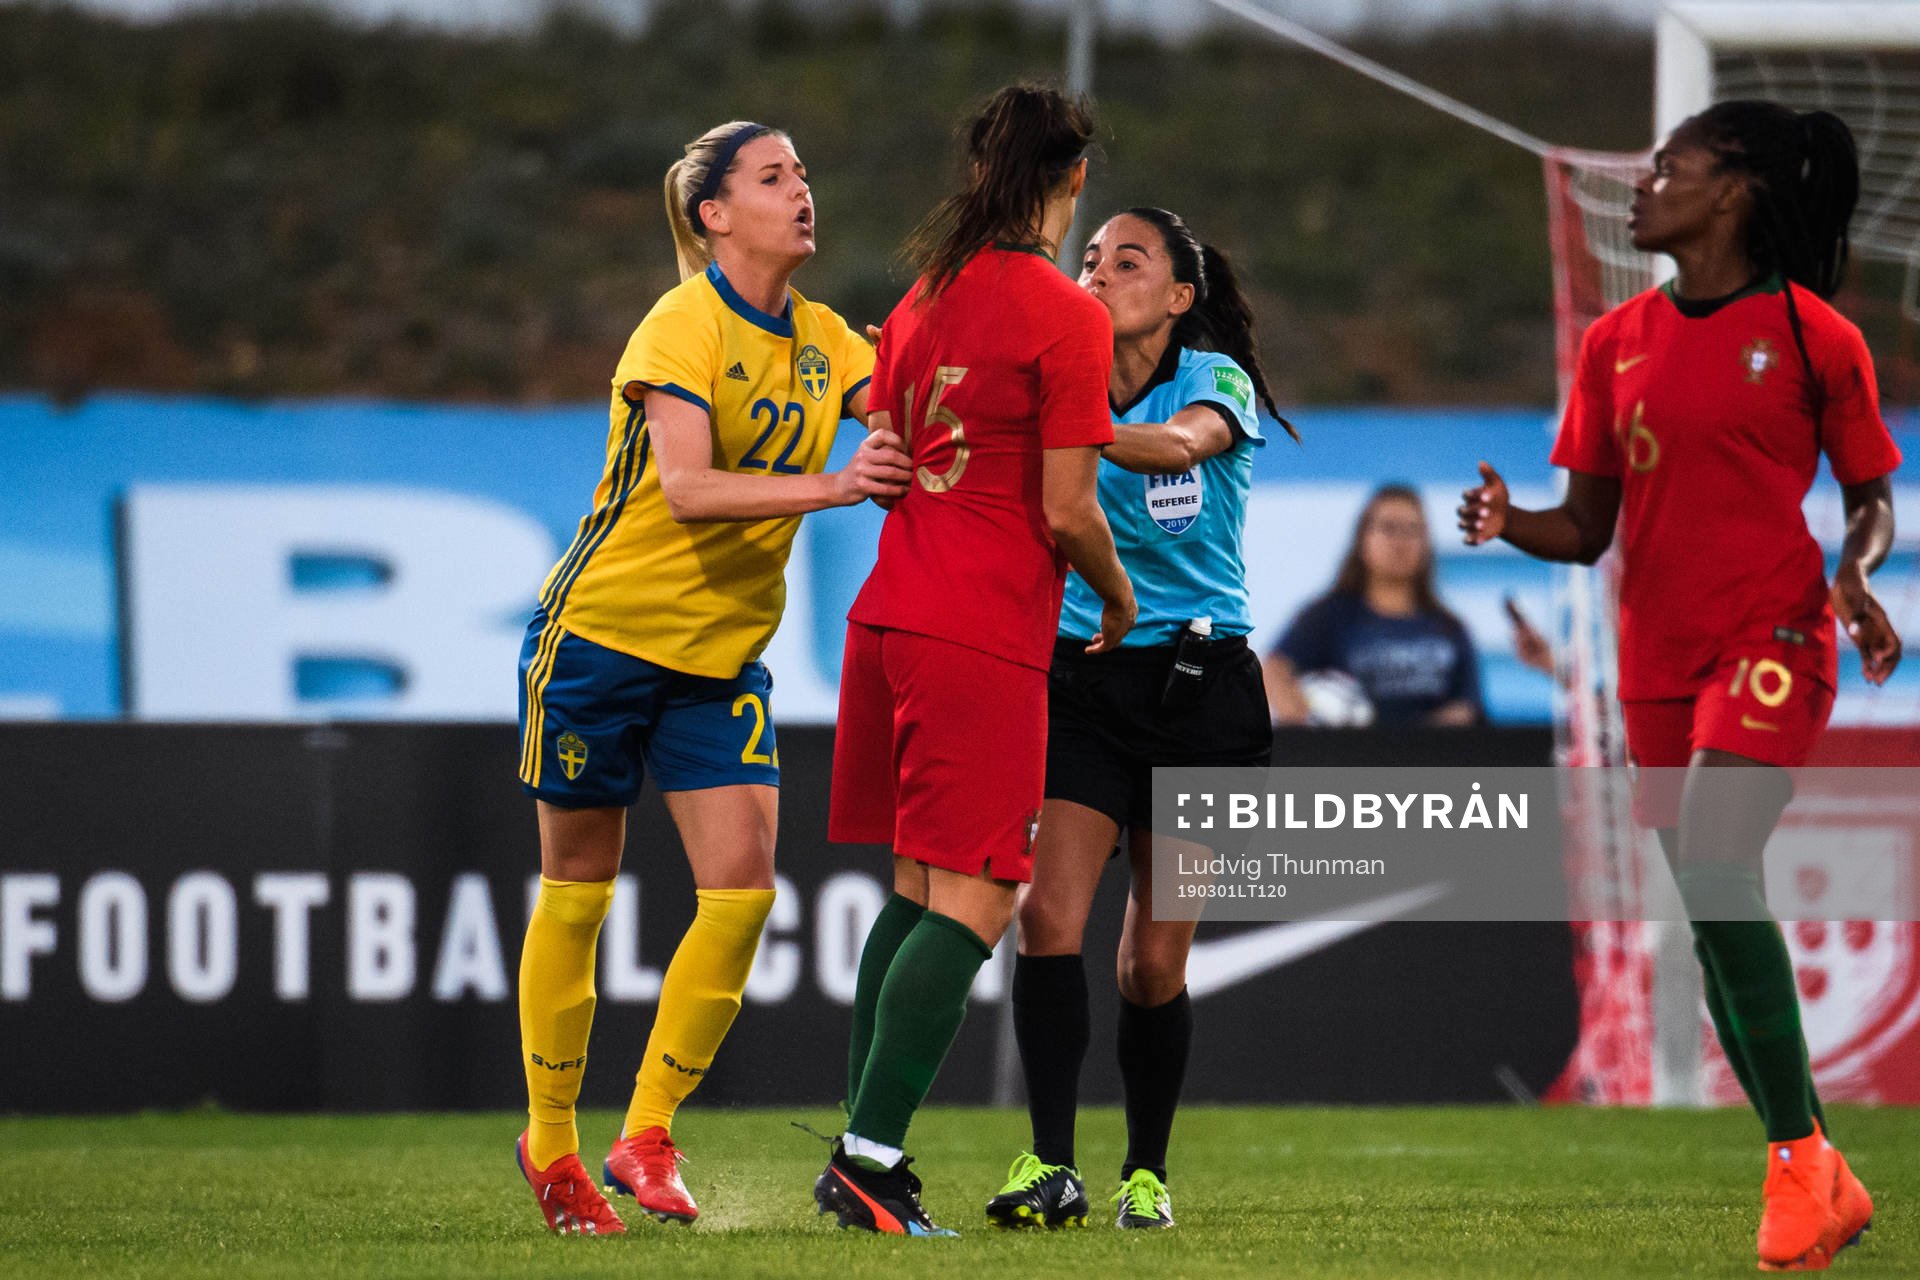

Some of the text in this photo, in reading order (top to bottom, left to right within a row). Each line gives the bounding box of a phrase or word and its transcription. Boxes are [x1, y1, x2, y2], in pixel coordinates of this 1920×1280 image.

[738, 397, 805, 474] 22
[903, 365, 970, 493] 15
[1149, 468, 1196, 489] FIFA
[1151, 495, 1198, 509] REFEREE
[1166, 519, 1188, 529] 2019
[1728, 658, 1792, 708] 10
[732, 693, 779, 768] 2
[531, 1053, 587, 1071] SvFF
[662, 1053, 710, 1077] SvF
